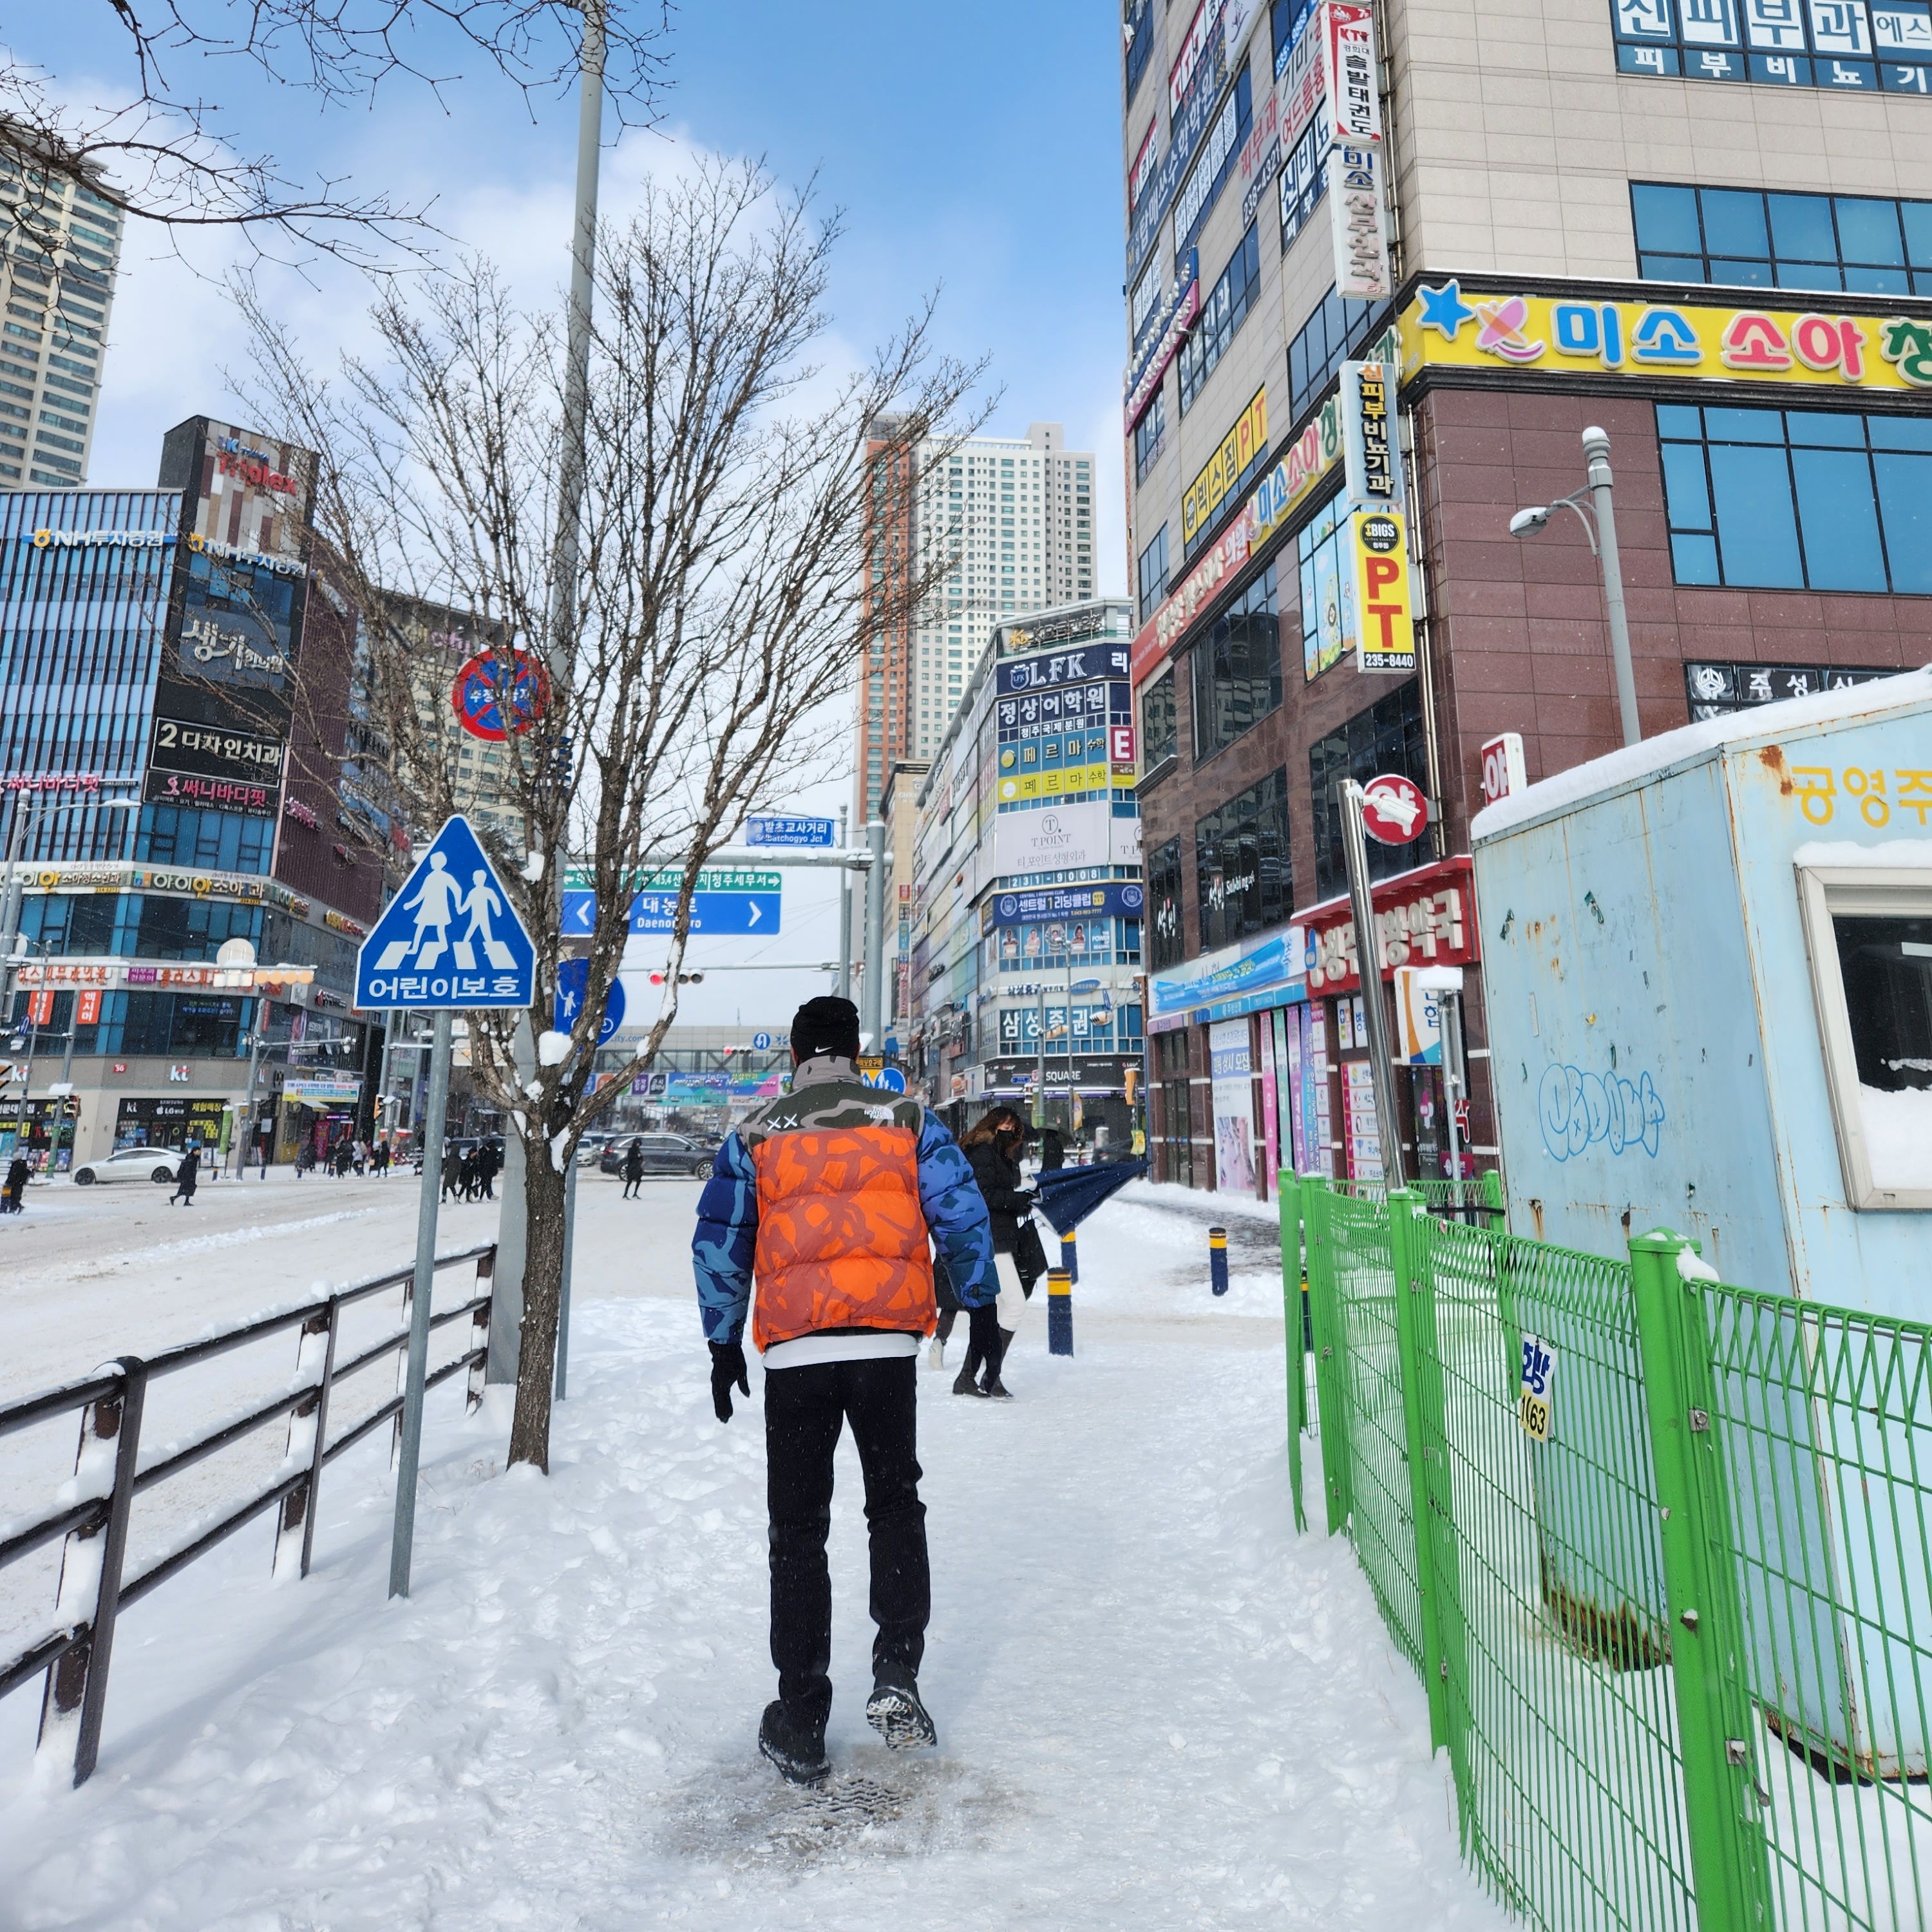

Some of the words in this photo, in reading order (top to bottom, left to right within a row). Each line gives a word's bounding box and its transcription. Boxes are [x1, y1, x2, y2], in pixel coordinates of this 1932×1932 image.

[1552, 301, 1705, 368] 미소
[54, 529, 165, 547] NH투자증권
[1371, 523, 1395, 537] BIGS
[1030, 652, 1088, 687] LFK
[1365, 653, 1414, 668] 235-8440
[469, 688, 529, 704] 주정금지
[999, 686, 1104, 725] 정상어학원
[1020, 717, 1084, 739] 청주국제분원
[1023, 739, 1083, 763] 페르마
[8, 773, 100, 793] 써니바디핏
[1024, 772, 1083, 793] 페르마
[1088, 770, 1107, 783] 수학
[182, 778, 267, 809] 써니바디핏
[1791, 766, 1932, 829] 공영주
[762, 821, 828, 835] 밭초교사거리
[810, 834, 824, 843] Jct
[153, 873, 212, 899] 아이안
[712, 875, 767, 888] 청주세무서
[1011, 869, 1098, 888] 231-9008
[1018, 897, 1047, 913] 센트럴
[1054, 892, 1092, 909] 리딩클럽
[368, 976, 521, 1000] 어린이보호
[170, 1065, 189, 1082] kt
[1045, 1070, 1081, 1081] SQUARE
